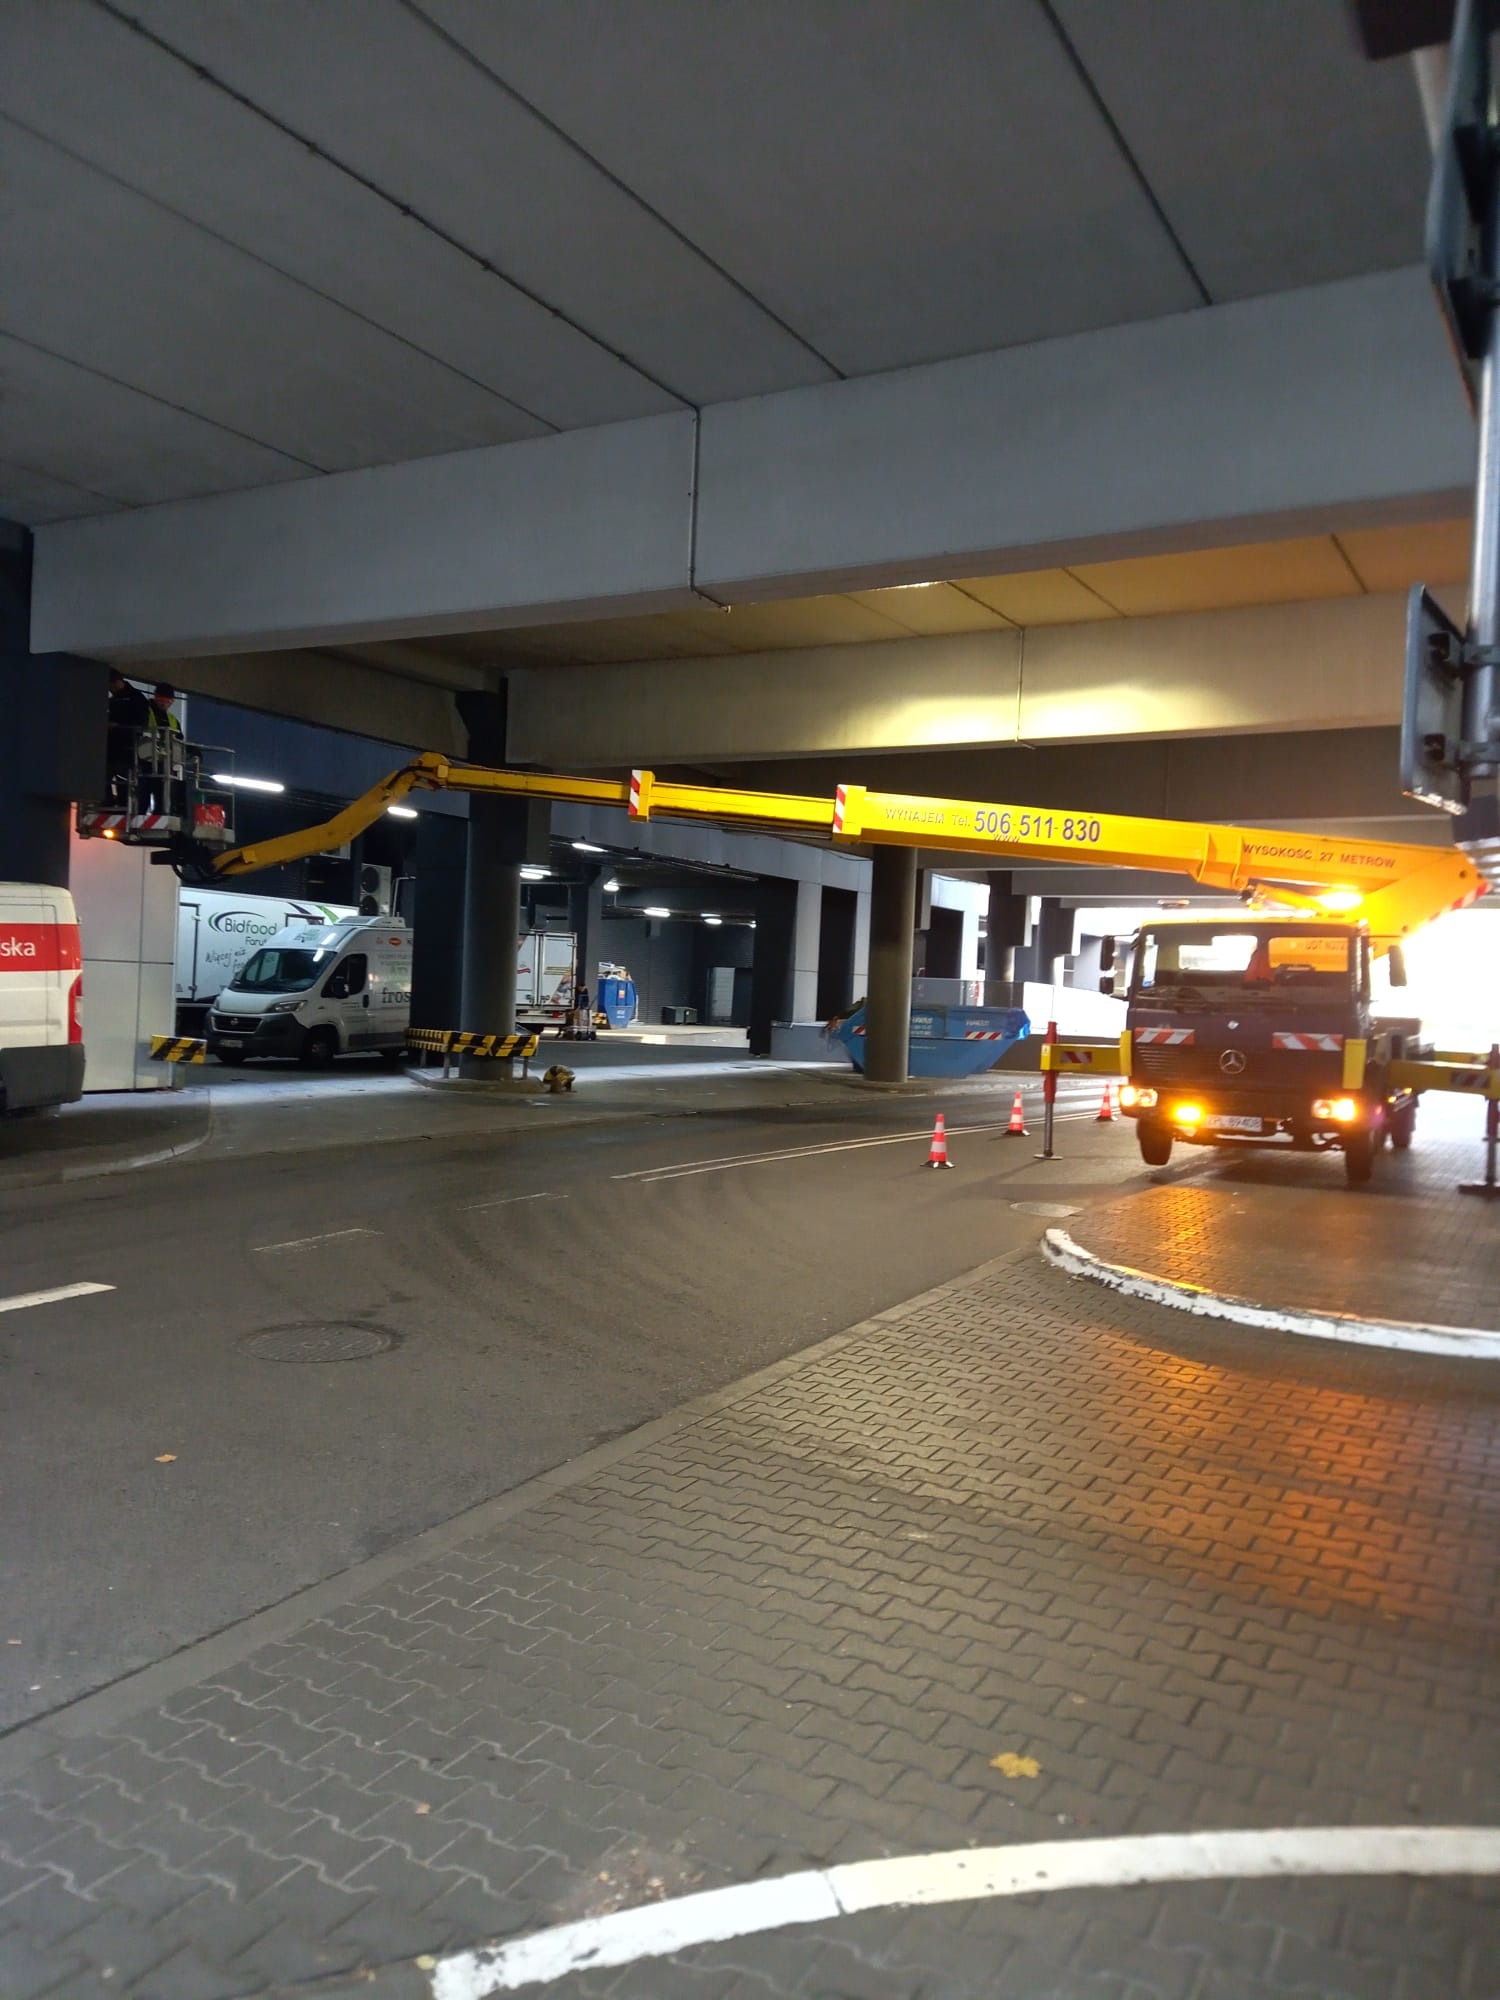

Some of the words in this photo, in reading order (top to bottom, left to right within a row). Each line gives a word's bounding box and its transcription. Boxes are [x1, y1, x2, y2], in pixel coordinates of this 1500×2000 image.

[885, 808, 945, 825] WYNAJEM
[1319, 851, 1334, 862] 27
[225, 918, 277, 936] Bidfood
[0, 936, 36, 957] ska
